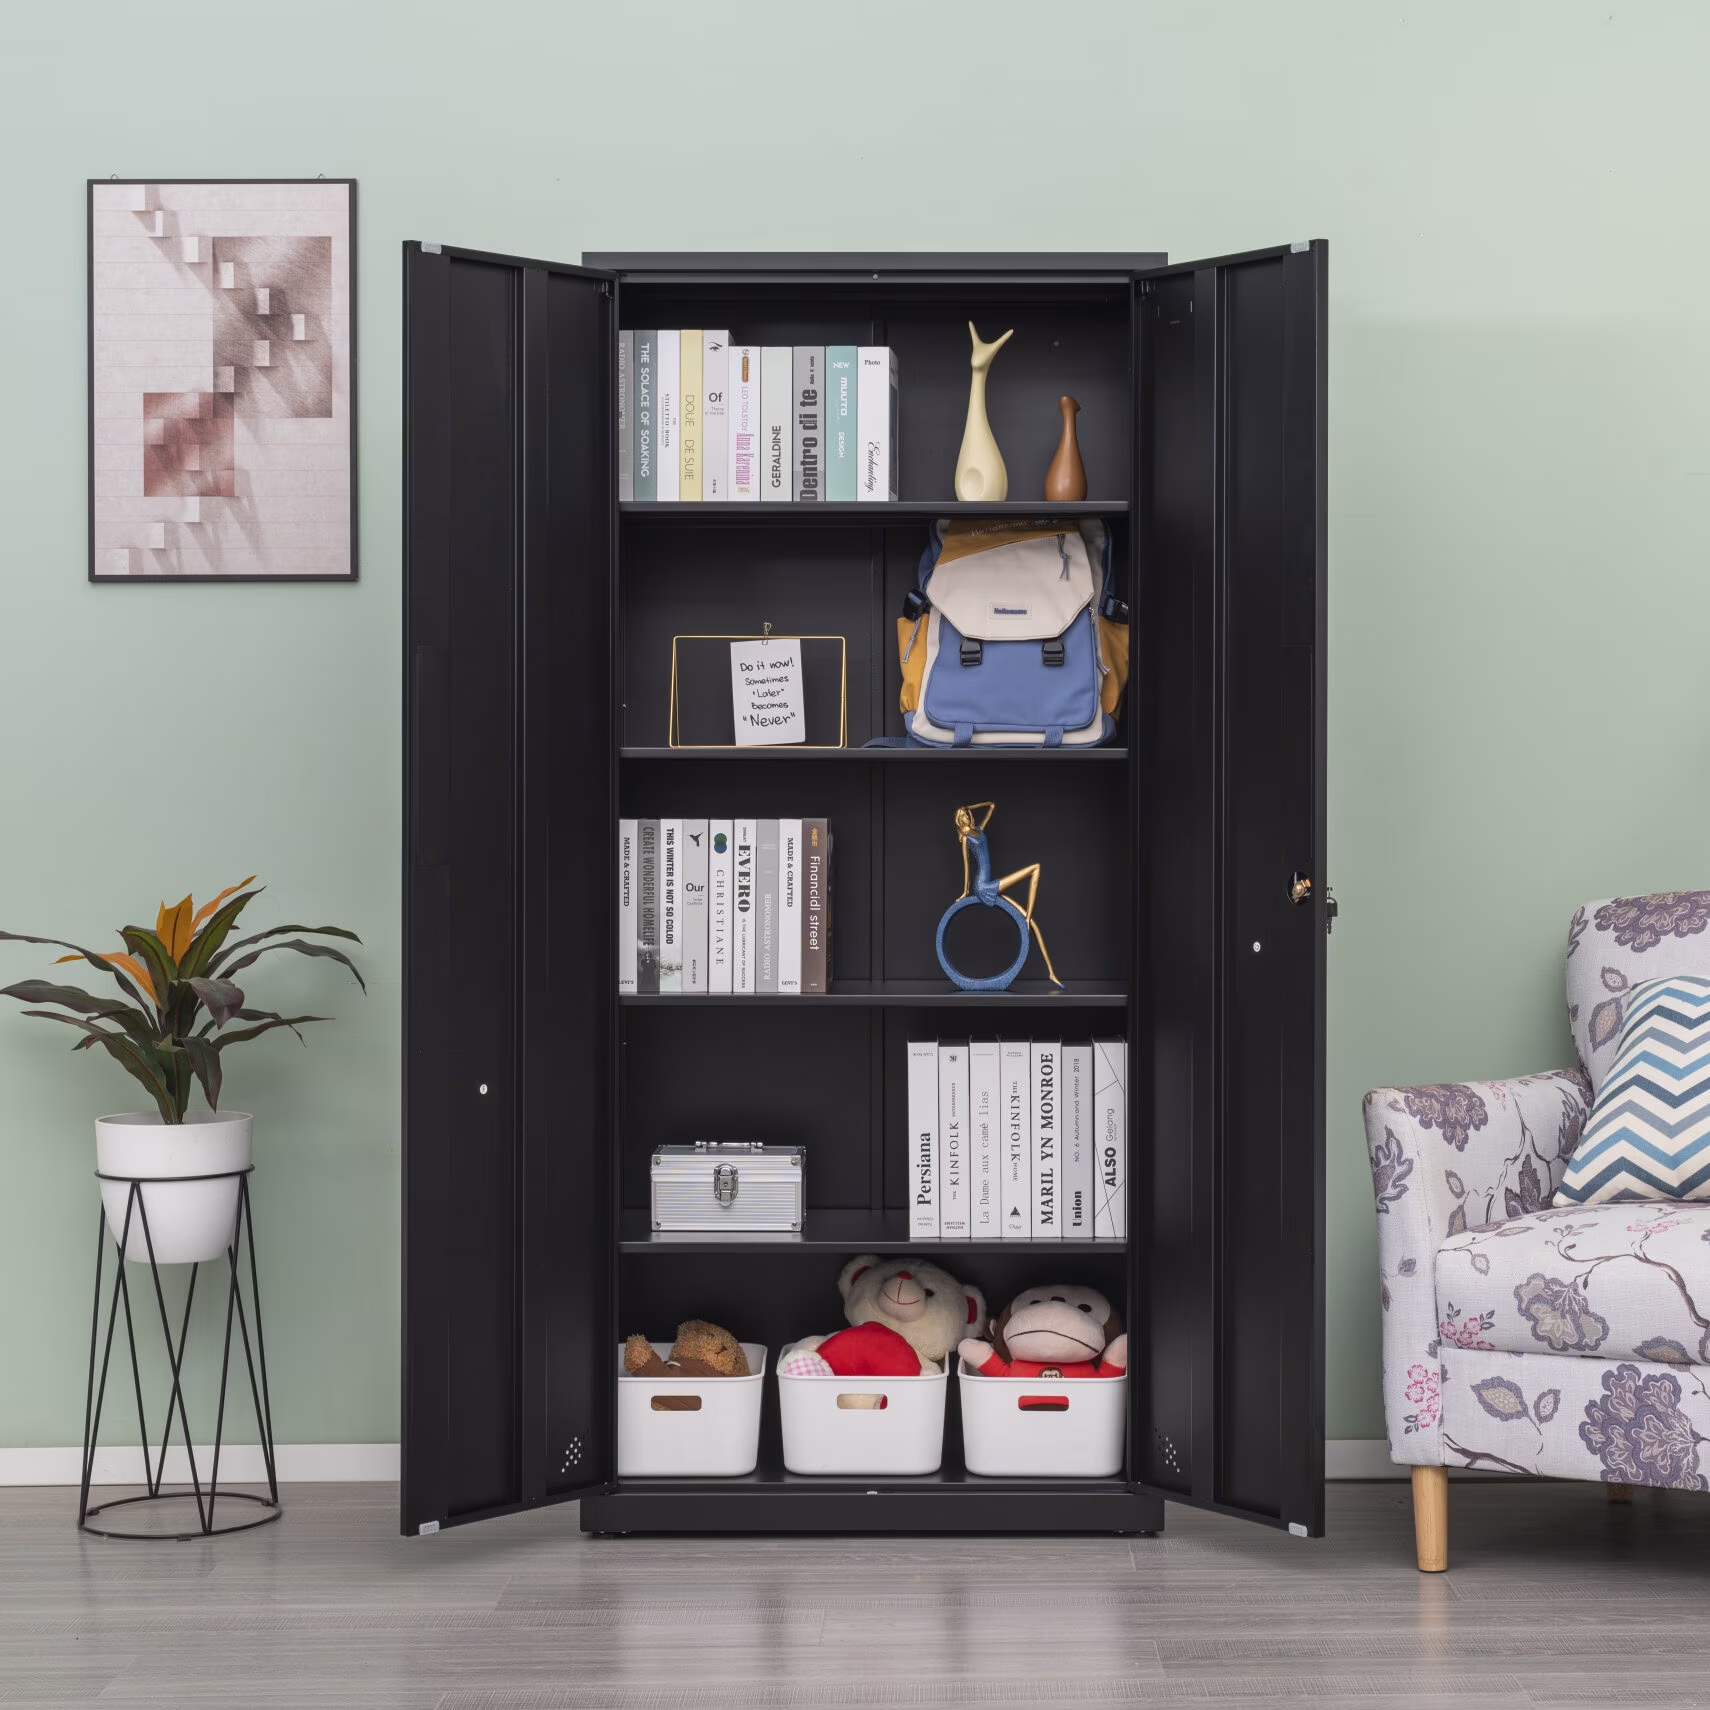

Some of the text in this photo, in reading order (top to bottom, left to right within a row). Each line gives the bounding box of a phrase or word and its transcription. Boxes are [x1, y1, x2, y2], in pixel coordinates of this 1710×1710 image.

[640, 343, 650, 478] THE SOLACE OF SOAKING
[685, 394, 694, 426] DOUE
[709, 392, 723, 402] Of
[736, 433, 754, 450] Anna
[772, 425, 781, 488] GERALDINE
[799, 389, 818, 501] Dentro di te
[685, 440, 694, 480] DE SUIE
[736, 454, 754, 485] Karenina
[740, 657, 794, 672] Do it now!
[745, 676, 789, 686] Sometimes
[666, 828, 674, 845] THIS
[666, 848, 674, 877] WINTER
[738, 845, 750, 913] EVERO
[642, 827, 654, 946] CREATE WONDERFUL HOMELIFE
[666, 889, 674, 904] NOT
[686, 883, 704, 892] Our
[666, 907, 674, 917] SO
[716, 870, 724, 965] CHRISTIANE
[764, 893, 772, 951] ASTRONOMER
[809, 915, 819, 950] street
[979, 1091, 989, 1115] lias
[980, 1123, 989, 1148] camé
[1011, 1095, 1020, 1162] KINFOLK
[1041, 1053, 1053, 1224] MARIL YN MONROE
[917, 1132, 931, 1206] Persiana
[950, 1122, 959, 1186] KINFOLK
[1105, 1147, 1116, 1187] ALSO
[980, 1180, 989, 1204] Dame
[1073, 1190, 1082, 1227] Union
[980, 1211, 989, 1224] La
